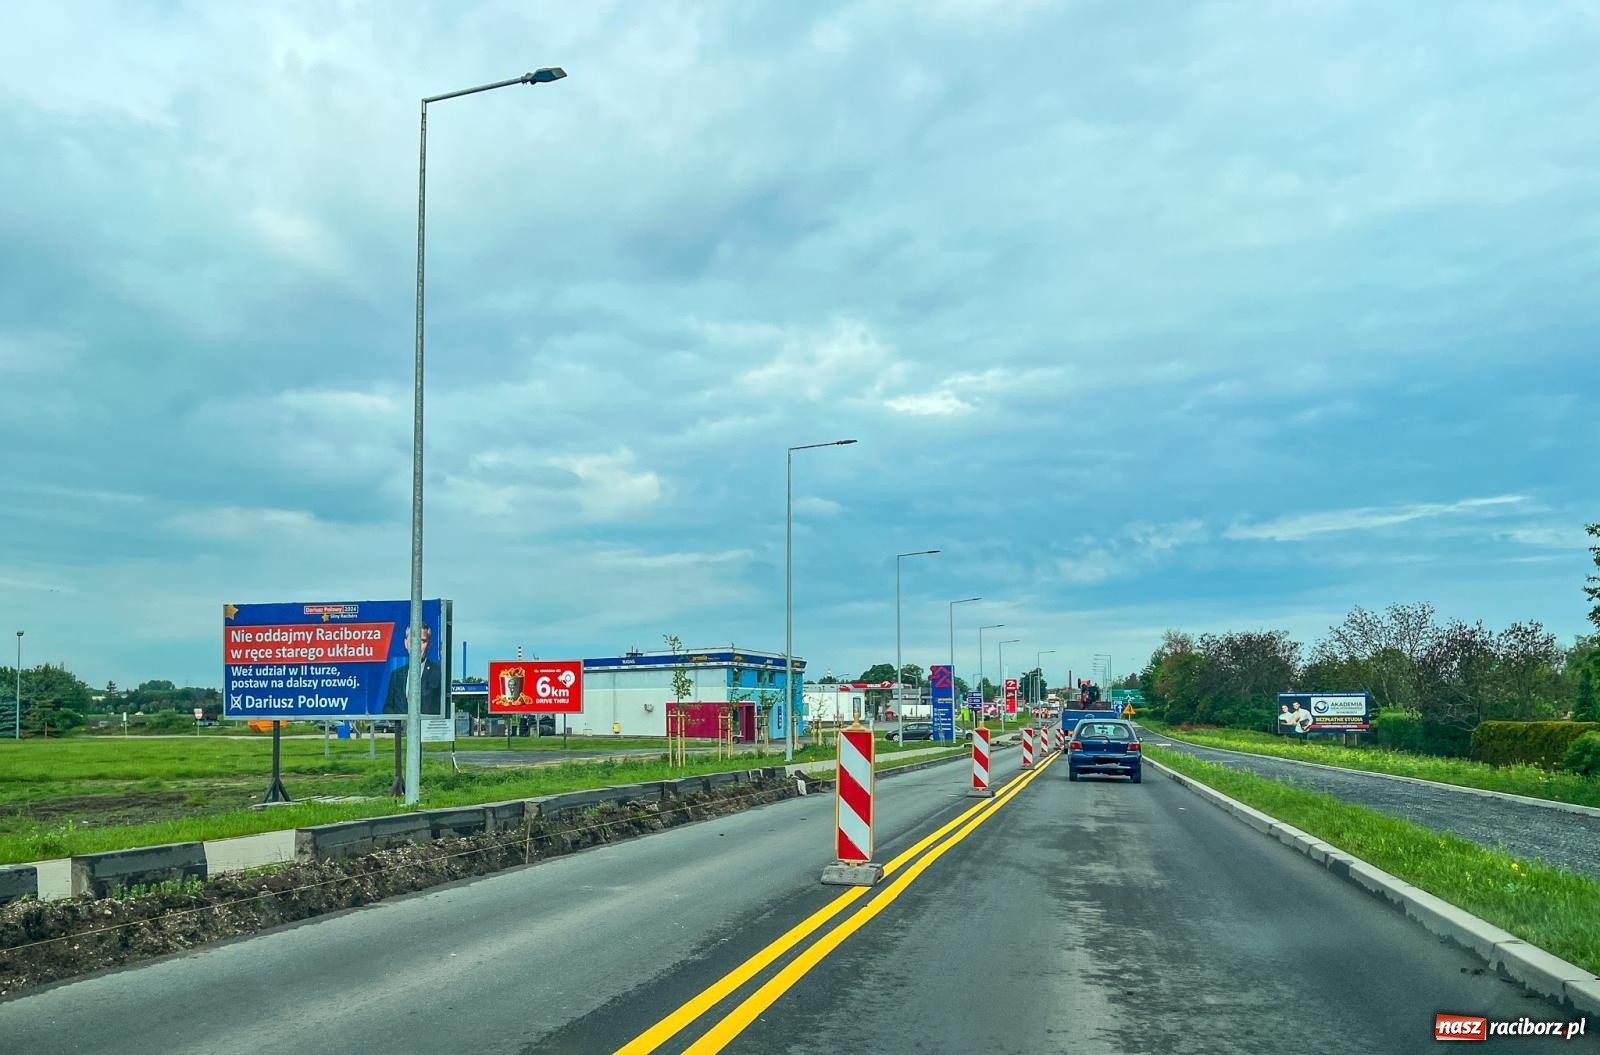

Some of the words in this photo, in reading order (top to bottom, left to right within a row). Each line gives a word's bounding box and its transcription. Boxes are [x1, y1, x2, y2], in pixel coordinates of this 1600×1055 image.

[231, 629, 253, 643] Nie
[255, 629, 312, 645] oddajmy
[315, 627, 381, 641] Raciborza
[230, 649, 244, 659] w
[245, 648, 273, 662] ręce
[275, 646, 325, 661] starego
[327, 643, 374, 657] układu
[231, 665, 253, 676] Weź
[255, 664, 286, 676] udział
[288, 667, 300, 676] w
[300, 665, 308, 676] II
[309, 666, 341, 677] turze,
[231, 678, 269, 690] postaw
[270, 679, 284, 688] na
[286, 676, 319, 690] dalszy
[320, 676, 360, 690] rozwój.
[536, 676, 552, 697] 6
[551, 686, 570, 697] km
[245, 695, 294, 709] Dariusz
[297, 694, 349, 711] Polowy
